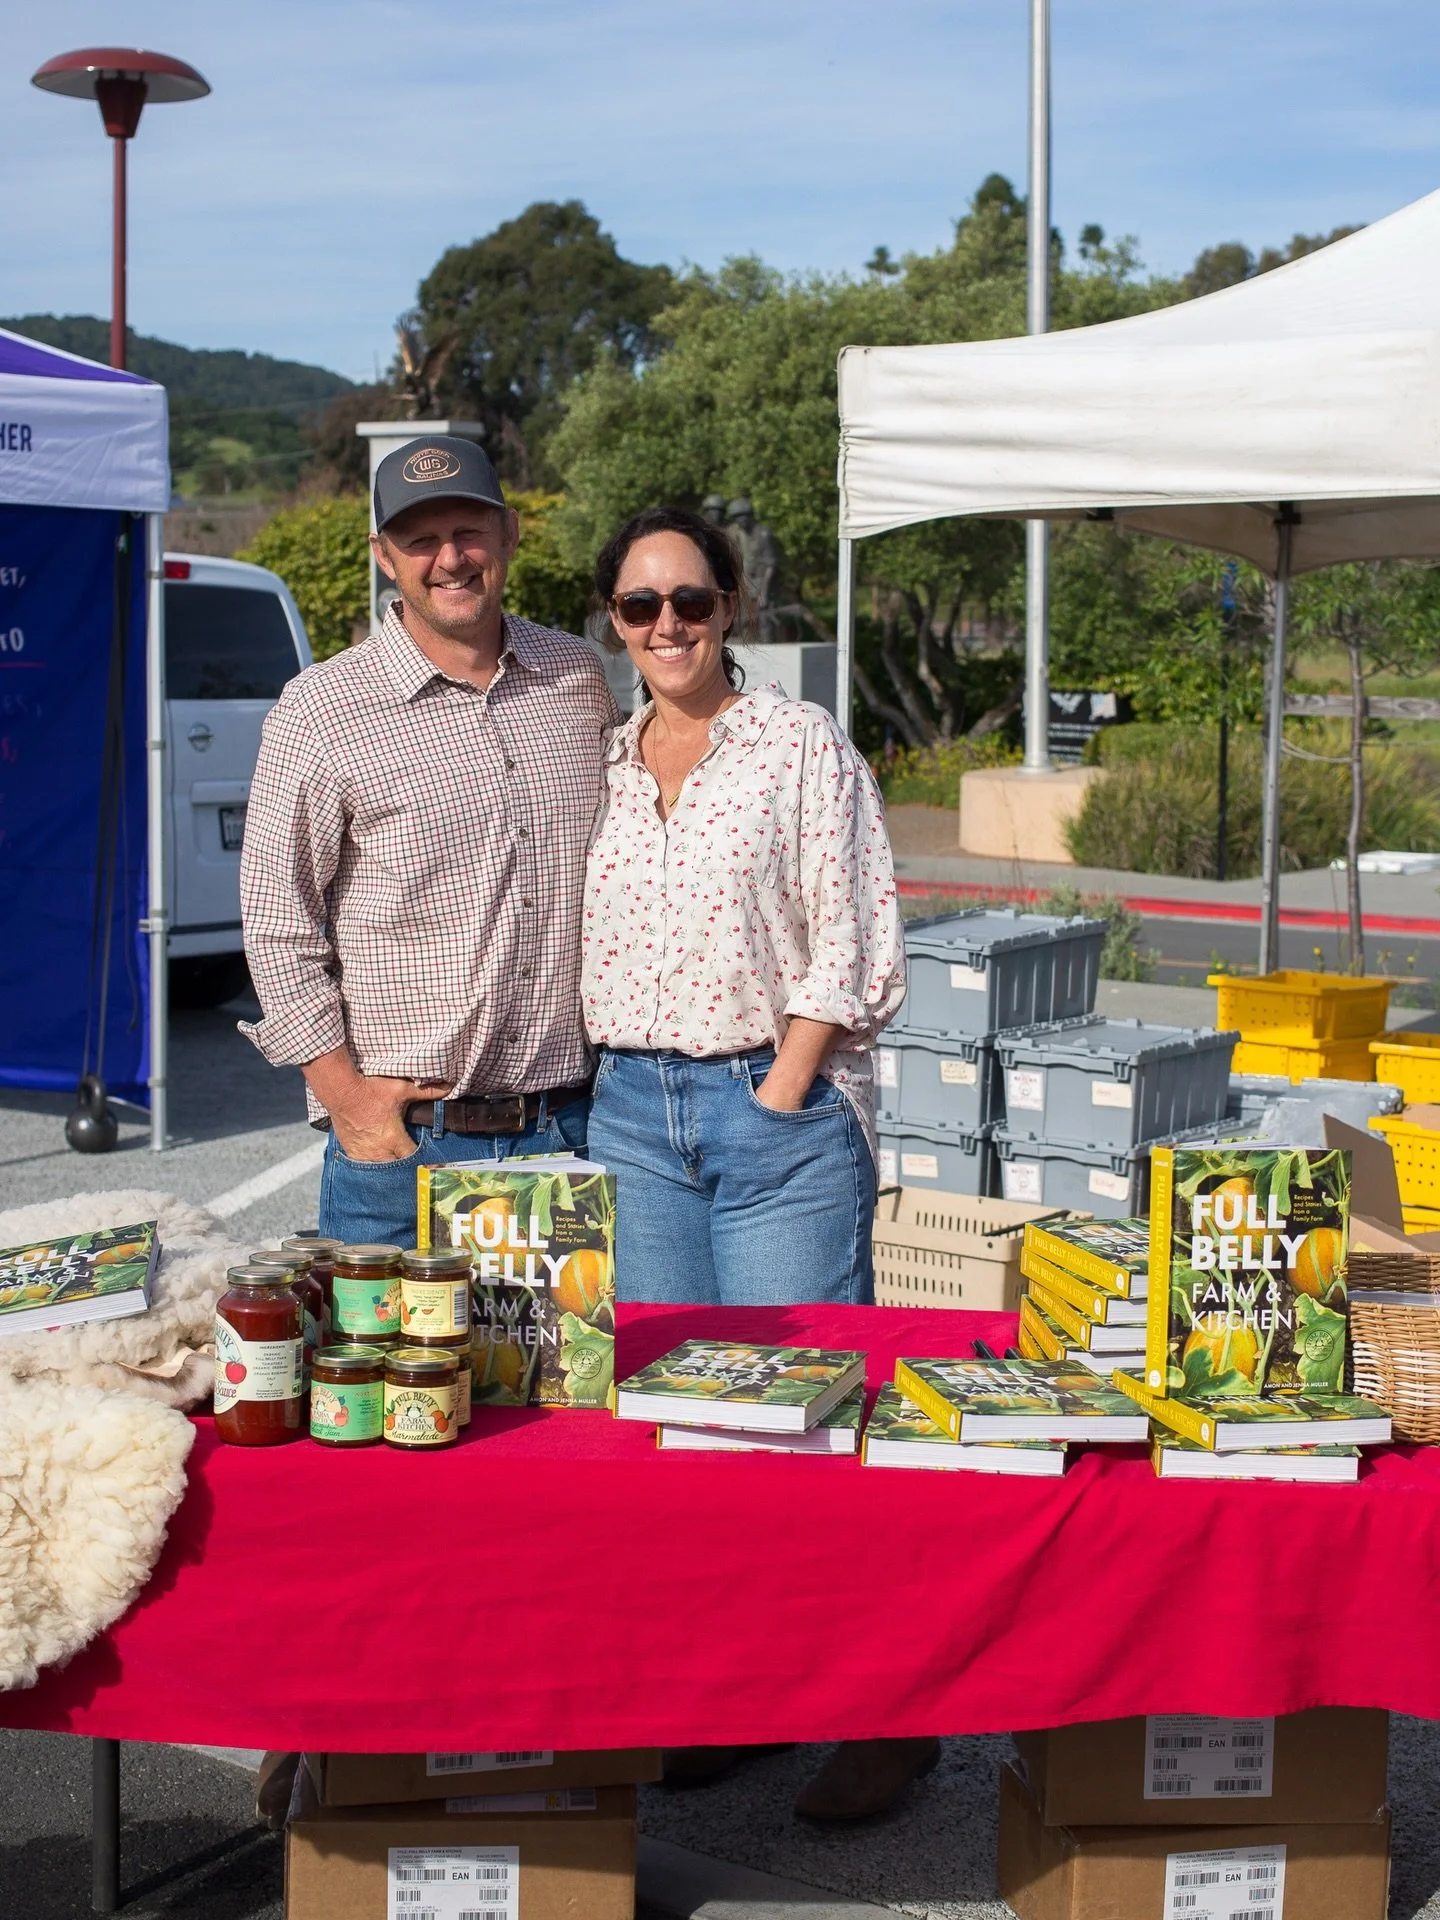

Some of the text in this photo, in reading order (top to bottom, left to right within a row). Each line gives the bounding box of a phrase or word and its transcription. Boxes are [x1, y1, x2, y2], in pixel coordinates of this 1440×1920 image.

[1156, 1175, 1166, 1207] FULL
[1192, 1194, 1287, 1230] FULL
[452, 1213, 549, 1249] FULL
[1155, 1211, 1165, 1252] BELLY
[1035, 1236, 1049, 1251] FULL
[1050, 1243, 1066, 1259] BELLY
[1067, 1251, 1083, 1267] FARM
[1089, 1263, 1114, 1283] KITCHEN
[1191, 1234, 1308, 1270] BELLY
[471, 1253, 571, 1287] ELLY
[1029, 1260, 1040, 1274] FULL
[1041, 1267, 1054, 1283] BELLY
[1153, 1256, 1163, 1289] FARM
[1192, 1281, 1282, 1304] FARM &
[472, 1298, 546, 1319] ARM &
[1191, 1309, 1293, 1330] KITCHEN
[471, 1326, 557, 1346] ITCHEN
[1151, 1306, 1162, 1364] KITCHEN
[679, 1357, 804, 1373] BELLY
[690, 1349, 785, 1364] FULL
[395, 1391, 411, 1406] FULL
[413, 1391, 437, 1408] BELLY
[1122, 1383, 1136, 1398] FULL
[1137, 1389, 1153, 1407] BELLY
[1153, 1399, 1169, 1416] FARM
[1175, 1411, 1199, 1433] KITCHEN
[391, 1430, 442, 1441] Marmalade
[1208, 1740, 1226, 1748] EAN
[452, 1871, 470, 1881] EAN
[1225, 1873, 1242, 1882] EAN
